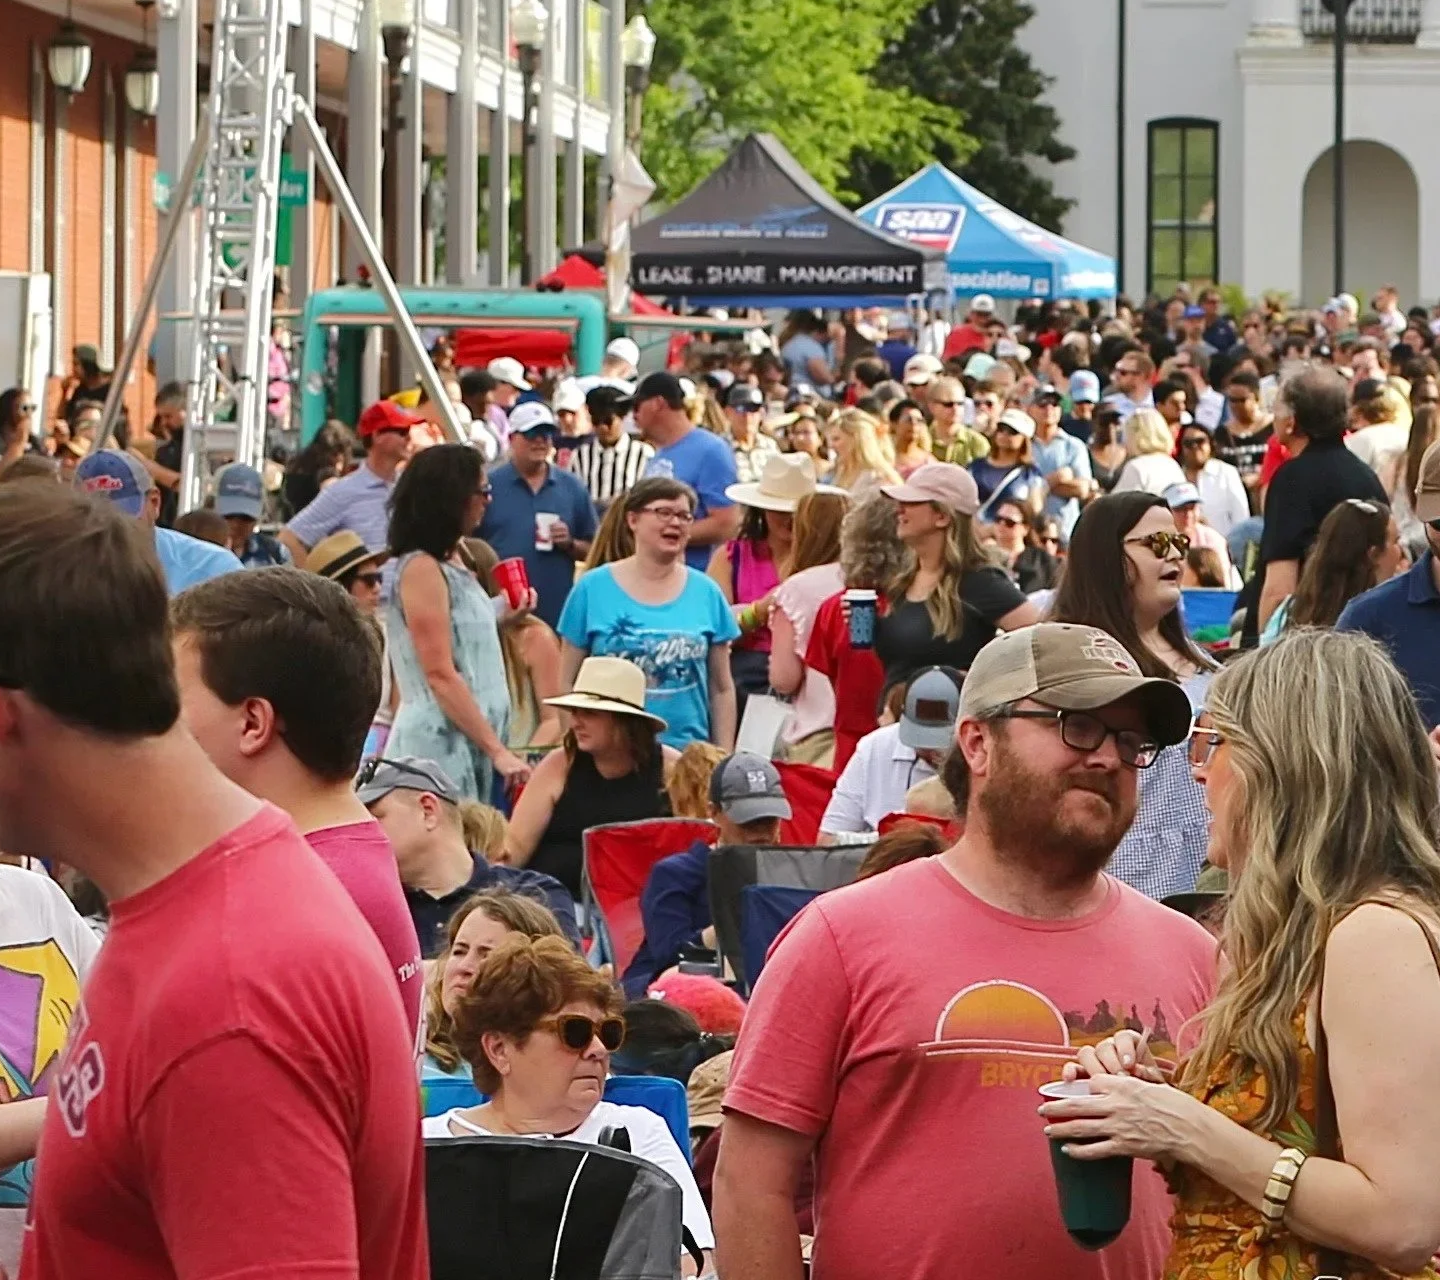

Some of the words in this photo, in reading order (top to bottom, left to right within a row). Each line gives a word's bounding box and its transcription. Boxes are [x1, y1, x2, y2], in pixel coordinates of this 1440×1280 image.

[639, 266, 692, 285] LEASE
[707, 266, 766, 285] SHARE
[779, 265, 917, 285] MANAGEMENT
